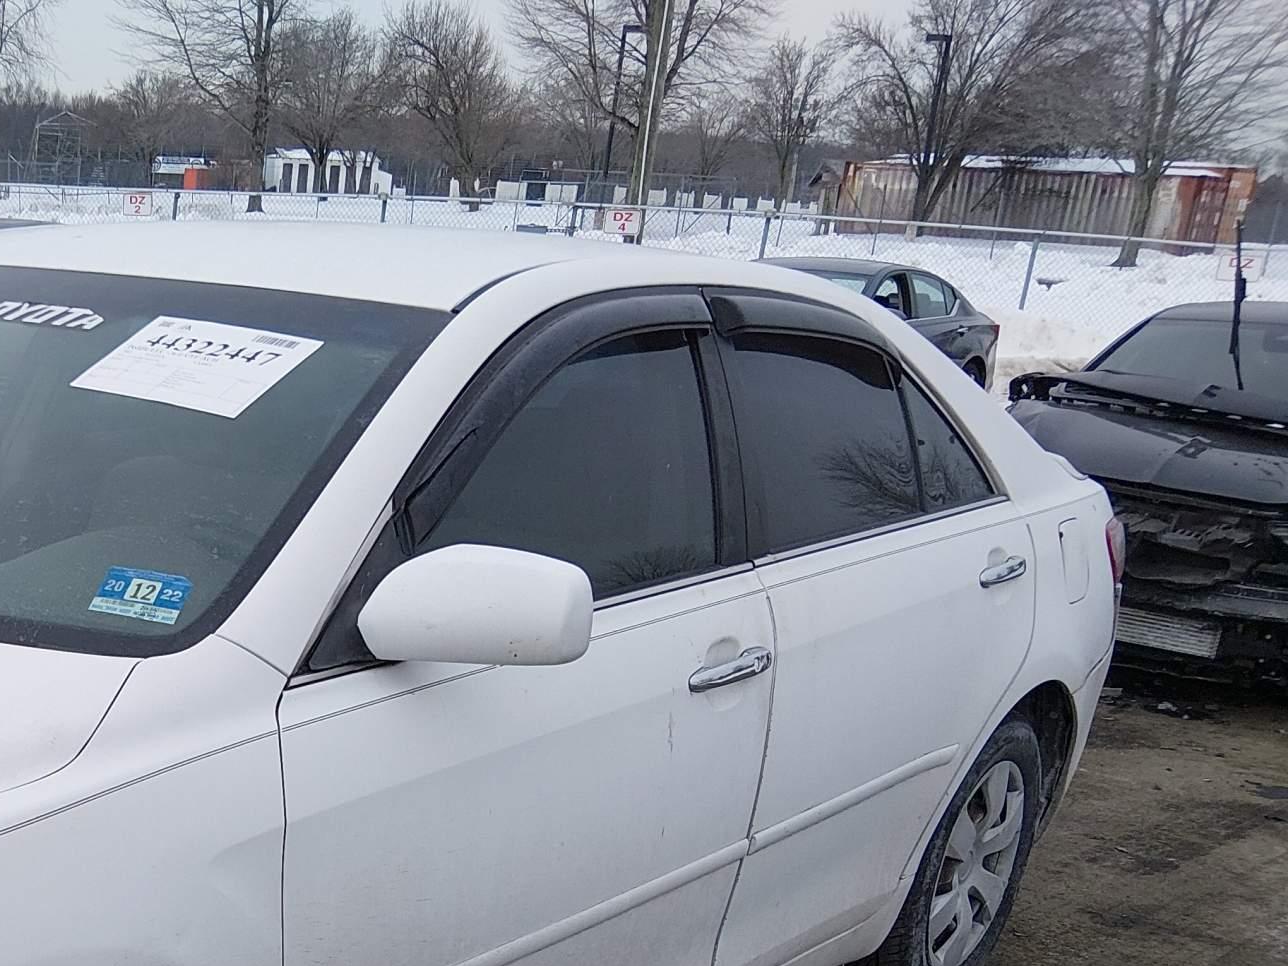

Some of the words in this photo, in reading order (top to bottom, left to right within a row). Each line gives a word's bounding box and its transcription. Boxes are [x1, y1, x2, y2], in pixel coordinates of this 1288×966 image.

[129, 195, 146, 205] DZ
[134, 205, 141, 214] 2
[613, 212, 633, 222] DZ
[618, 223, 625, 231] 4
[146, 333, 283, 366] 44322447
[104, 579, 125, 592] 20
[129, 582, 157, 602] 12
[160, 588, 183, 602] 22
